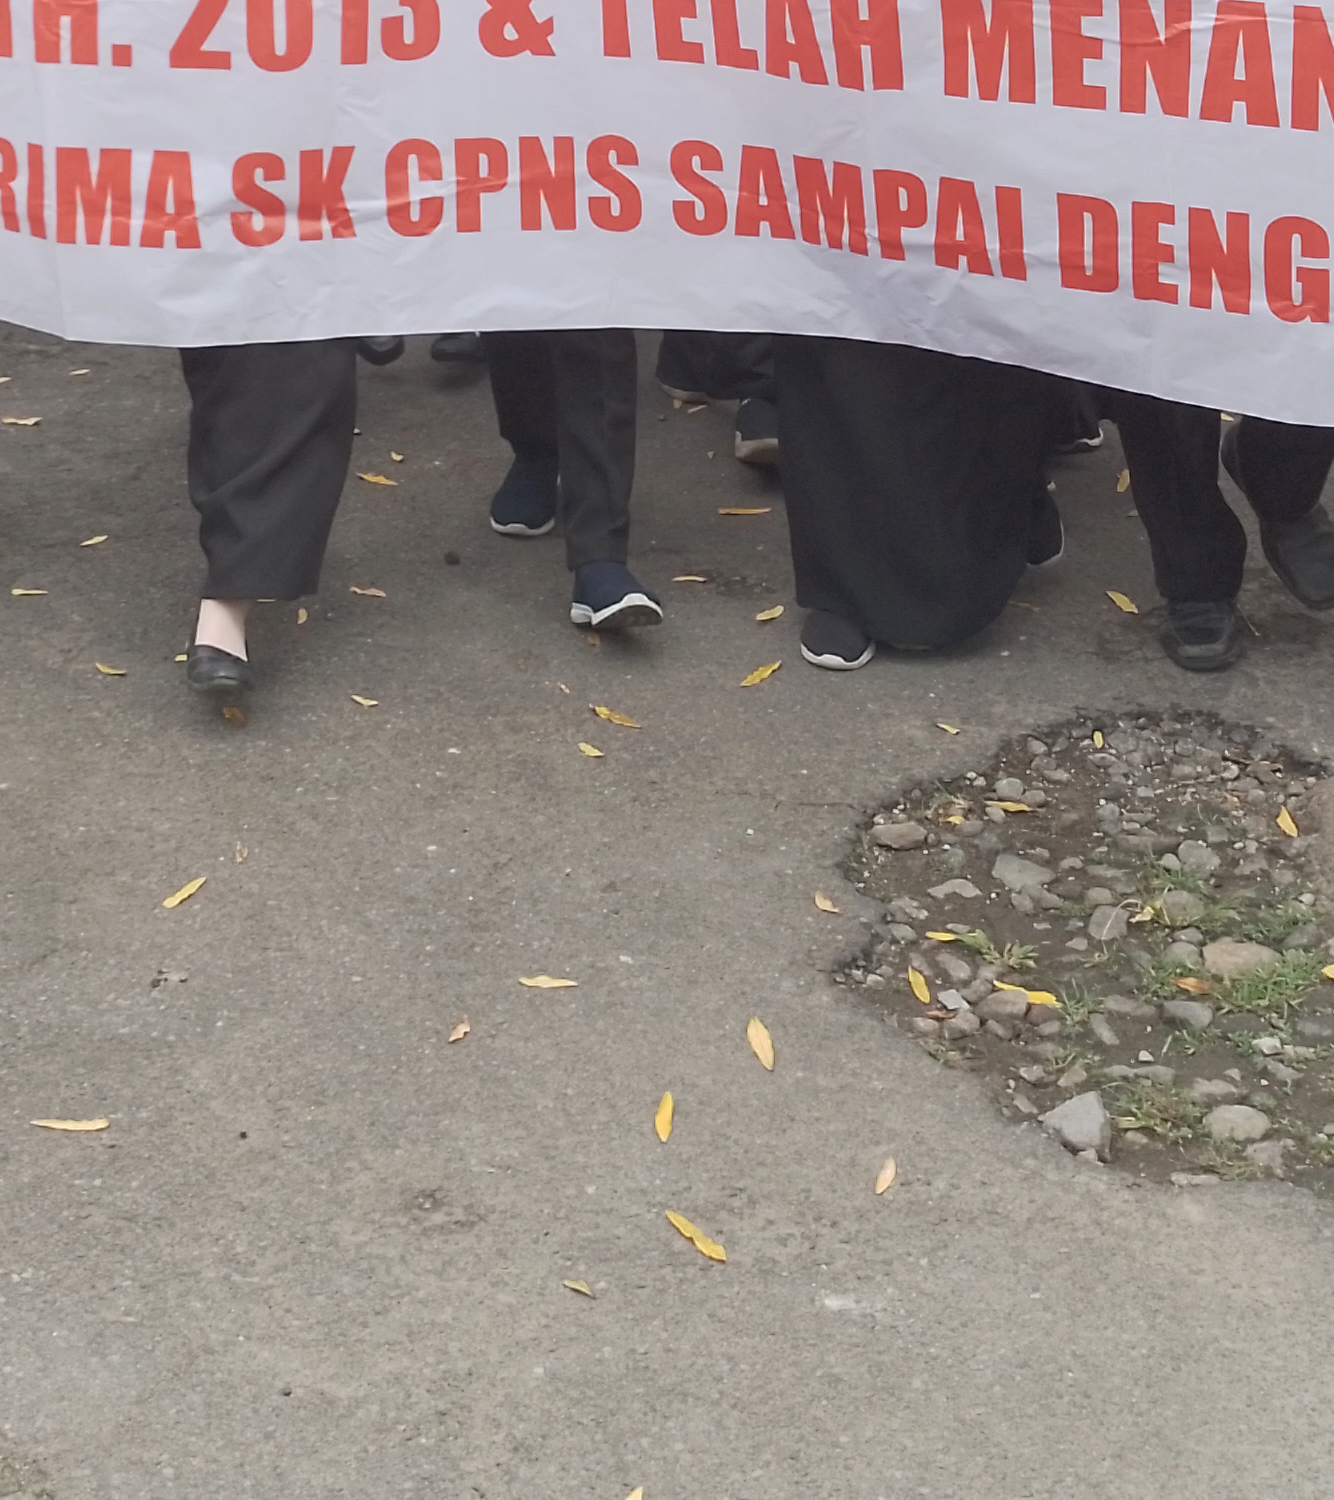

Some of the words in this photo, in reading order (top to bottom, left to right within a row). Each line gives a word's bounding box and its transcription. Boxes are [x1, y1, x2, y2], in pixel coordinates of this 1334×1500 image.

[229, 145, 357, 248] SK
[384, 135, 643, 237] CPNS
[670, 139, 1028, 281] SAMPAI
